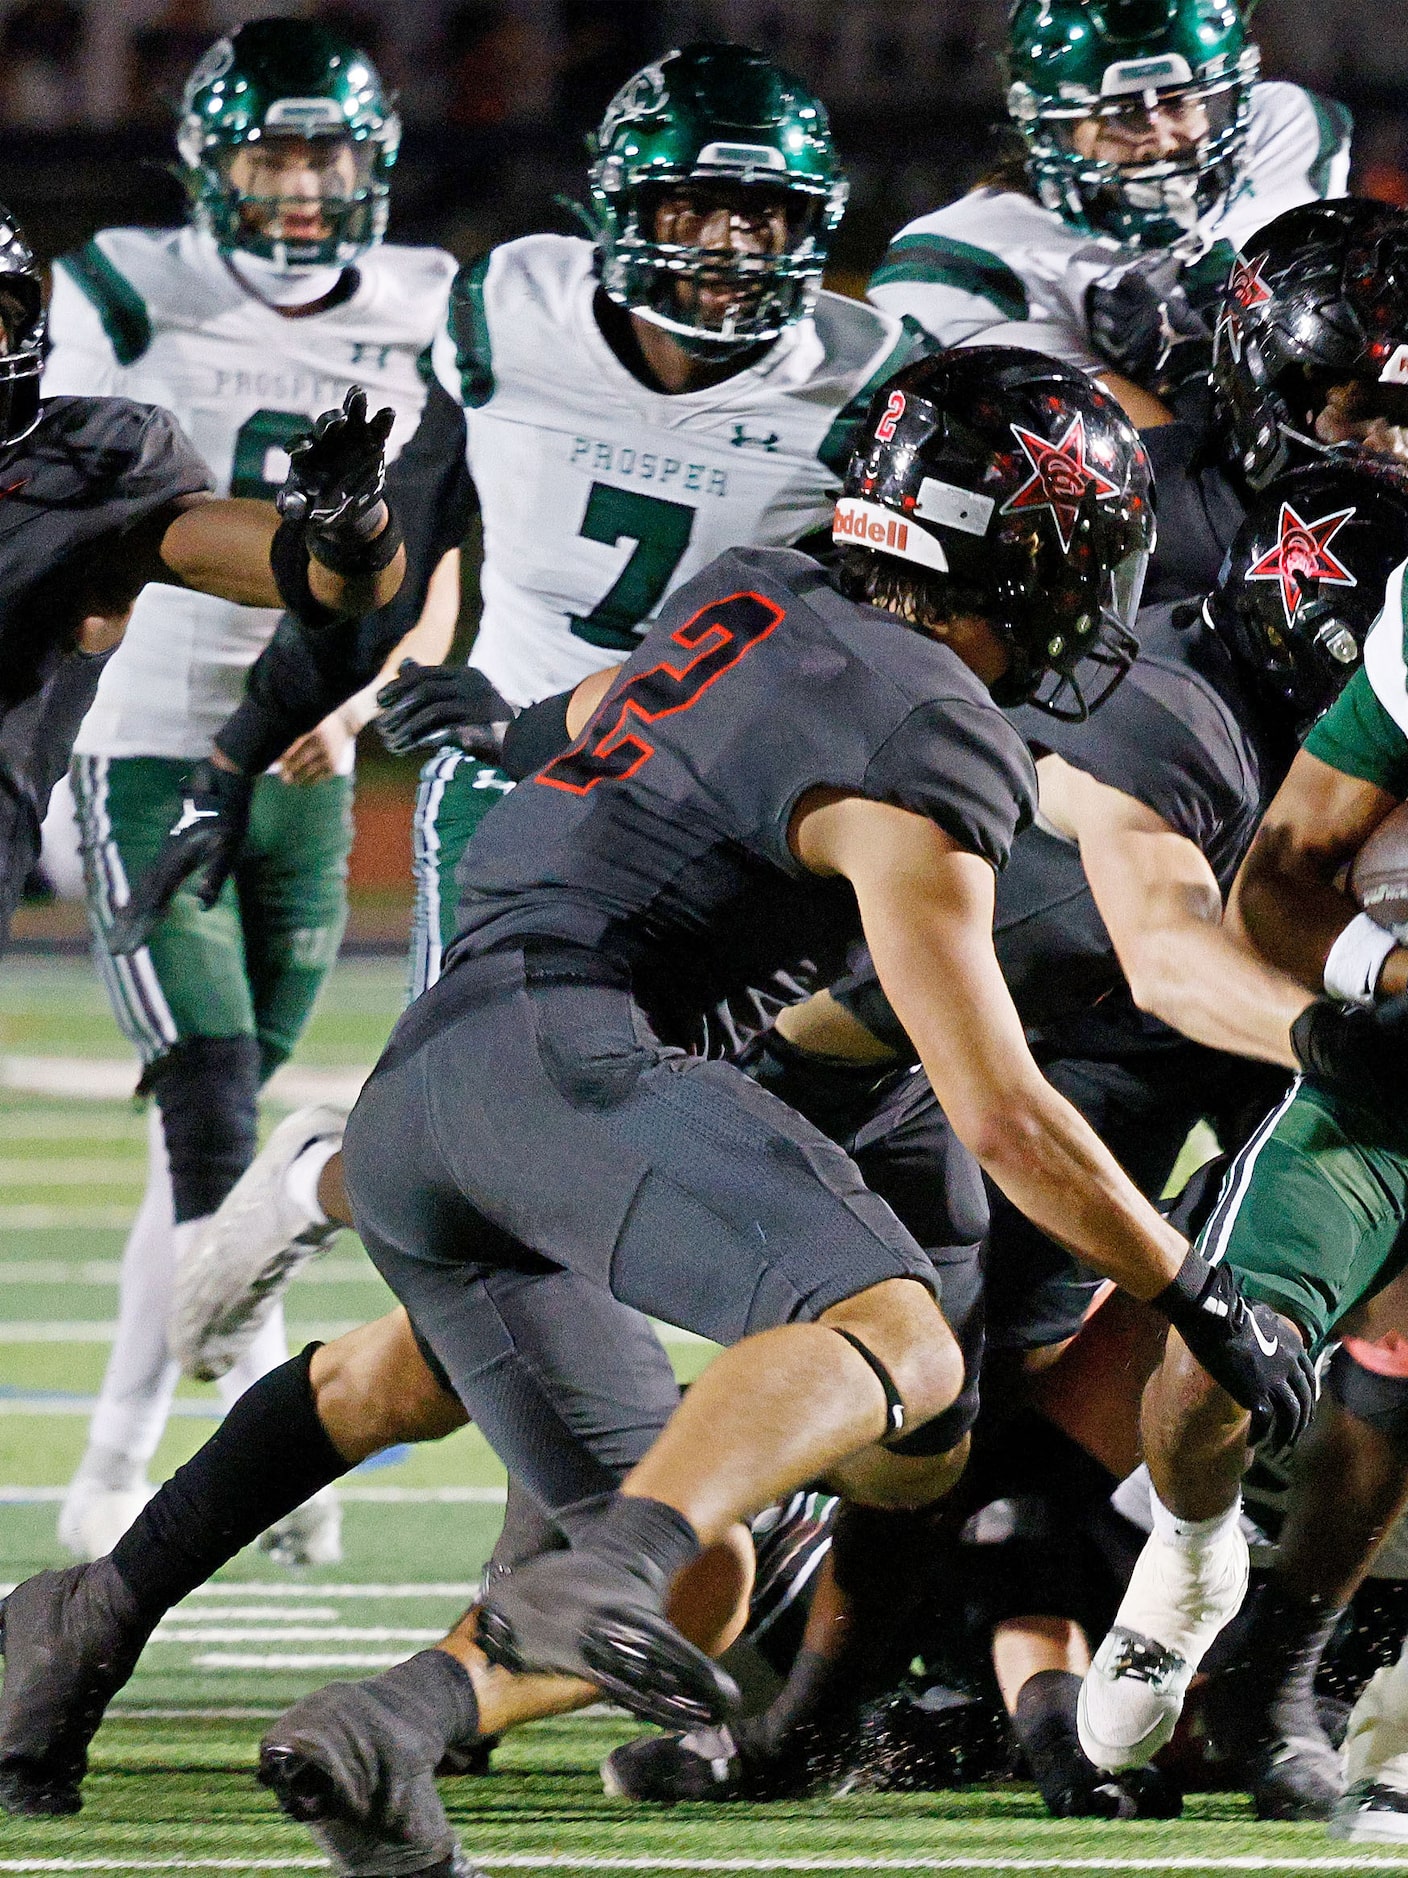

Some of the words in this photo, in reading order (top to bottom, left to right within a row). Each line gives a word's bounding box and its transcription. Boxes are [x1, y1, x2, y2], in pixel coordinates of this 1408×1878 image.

[569, 436, 728, 497] PROSPER
[873, 388, 907, 443] 2
[562, 480, 698, 652] 7
[533, 590, 786, 796] 2
